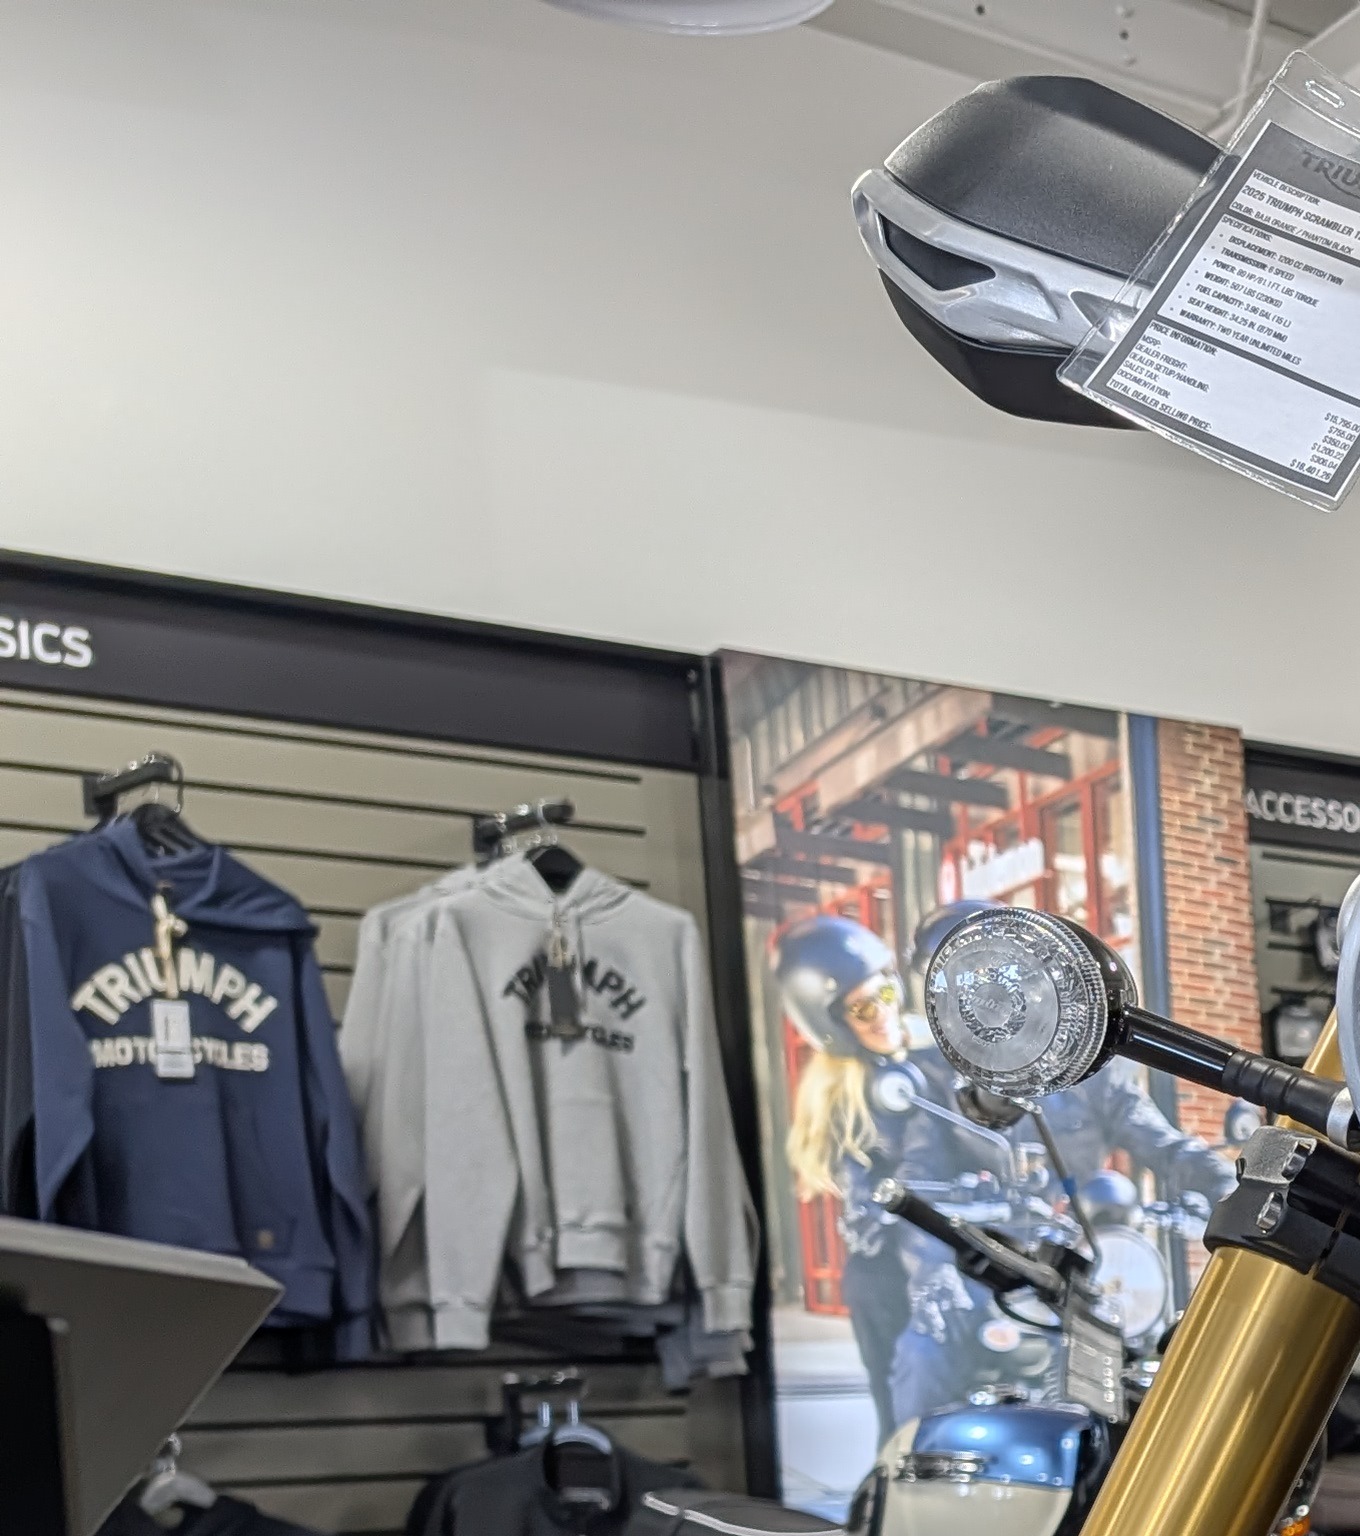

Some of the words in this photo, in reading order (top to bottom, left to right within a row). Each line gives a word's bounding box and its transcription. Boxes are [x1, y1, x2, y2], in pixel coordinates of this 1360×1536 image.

[1253, 171, 1281, 190] VEHICLE
[1241, 185, 1265, 202] 2025
[1266, 195, 1304, 218] TRIUMPH
[1303, 211, 1353, 236] SCRAMBLER
[1231, 201, 1254, 216] COLOR:
[1254, 212, 1271, 224] BAJA
[1270, 218, 1296, 233] ORANGE
[1301, 231, 1333, 247] PHANTOM
[1332, 242, 1354, 255] BLACK
[1204, 272, 1231, 287] WEIGHT:
[1230, 282, 1245, 292] 507
[1242, 286, 1257, 297] LBS
[1212, 259, 1237, 274] POWER:
[1281, 286, 1294, 296] LBS
[1293, 291, 1320, 307] TORQUE
[1273, 268, 1295, 281] SPEED
[1278, 254, 1295, 265] 1200
[1293, 260, 1303, 269] CC
[1302, 264, 1328, 278] BRITISH
[1327, 275, 1344, 285] TWIN
[1187, 297, 1206, 308] SEAT
[1204, 304, 1231, 320] HEIGHT:
[1229, 313, 1251, 325] 34.25
[1196, 284, 1213, 296] FUEL
[1211, 290, 1244, 309] CAPACITY:
[1244, 303, 1260, 313] 3.96
[1258, 309, 1272, 320] GAL
[1142, 335, 1162, 349] MSRP:
[1149, 322, 1171, 336] PRICE
[1170, 329, 1218, 356] INFORMATION:
[1179, 309, 1217, 329] WARRANTY:
[1217, 324, 1233, 335] TWO
[1231, 331, 1251, 343] YEAR
[1249, 338, 1283, 357] UNLIMITED
[1281, 350, 1302, 365] MILES
[1122, 360, 1145, 376] SALES
[1143, 370, 1160, 382] TAX:
[1129, 352, 1155, 368] DEALER
[1135, 343, 1161, 360] DEALER
[1160, 353, 1188, 371] FREIGHT:
[1116, 368, 1171, 398] DOCUMENTATION:
[1109, 378, 1133, 393] TOTAL
[1132, 389, 1161, 407] DEALER
[1159, 401, 1190, 421] SELLING
[1187, 414, 1213, 431] PRICE:
[72, 947, 278, 1033] TRIUMPH
